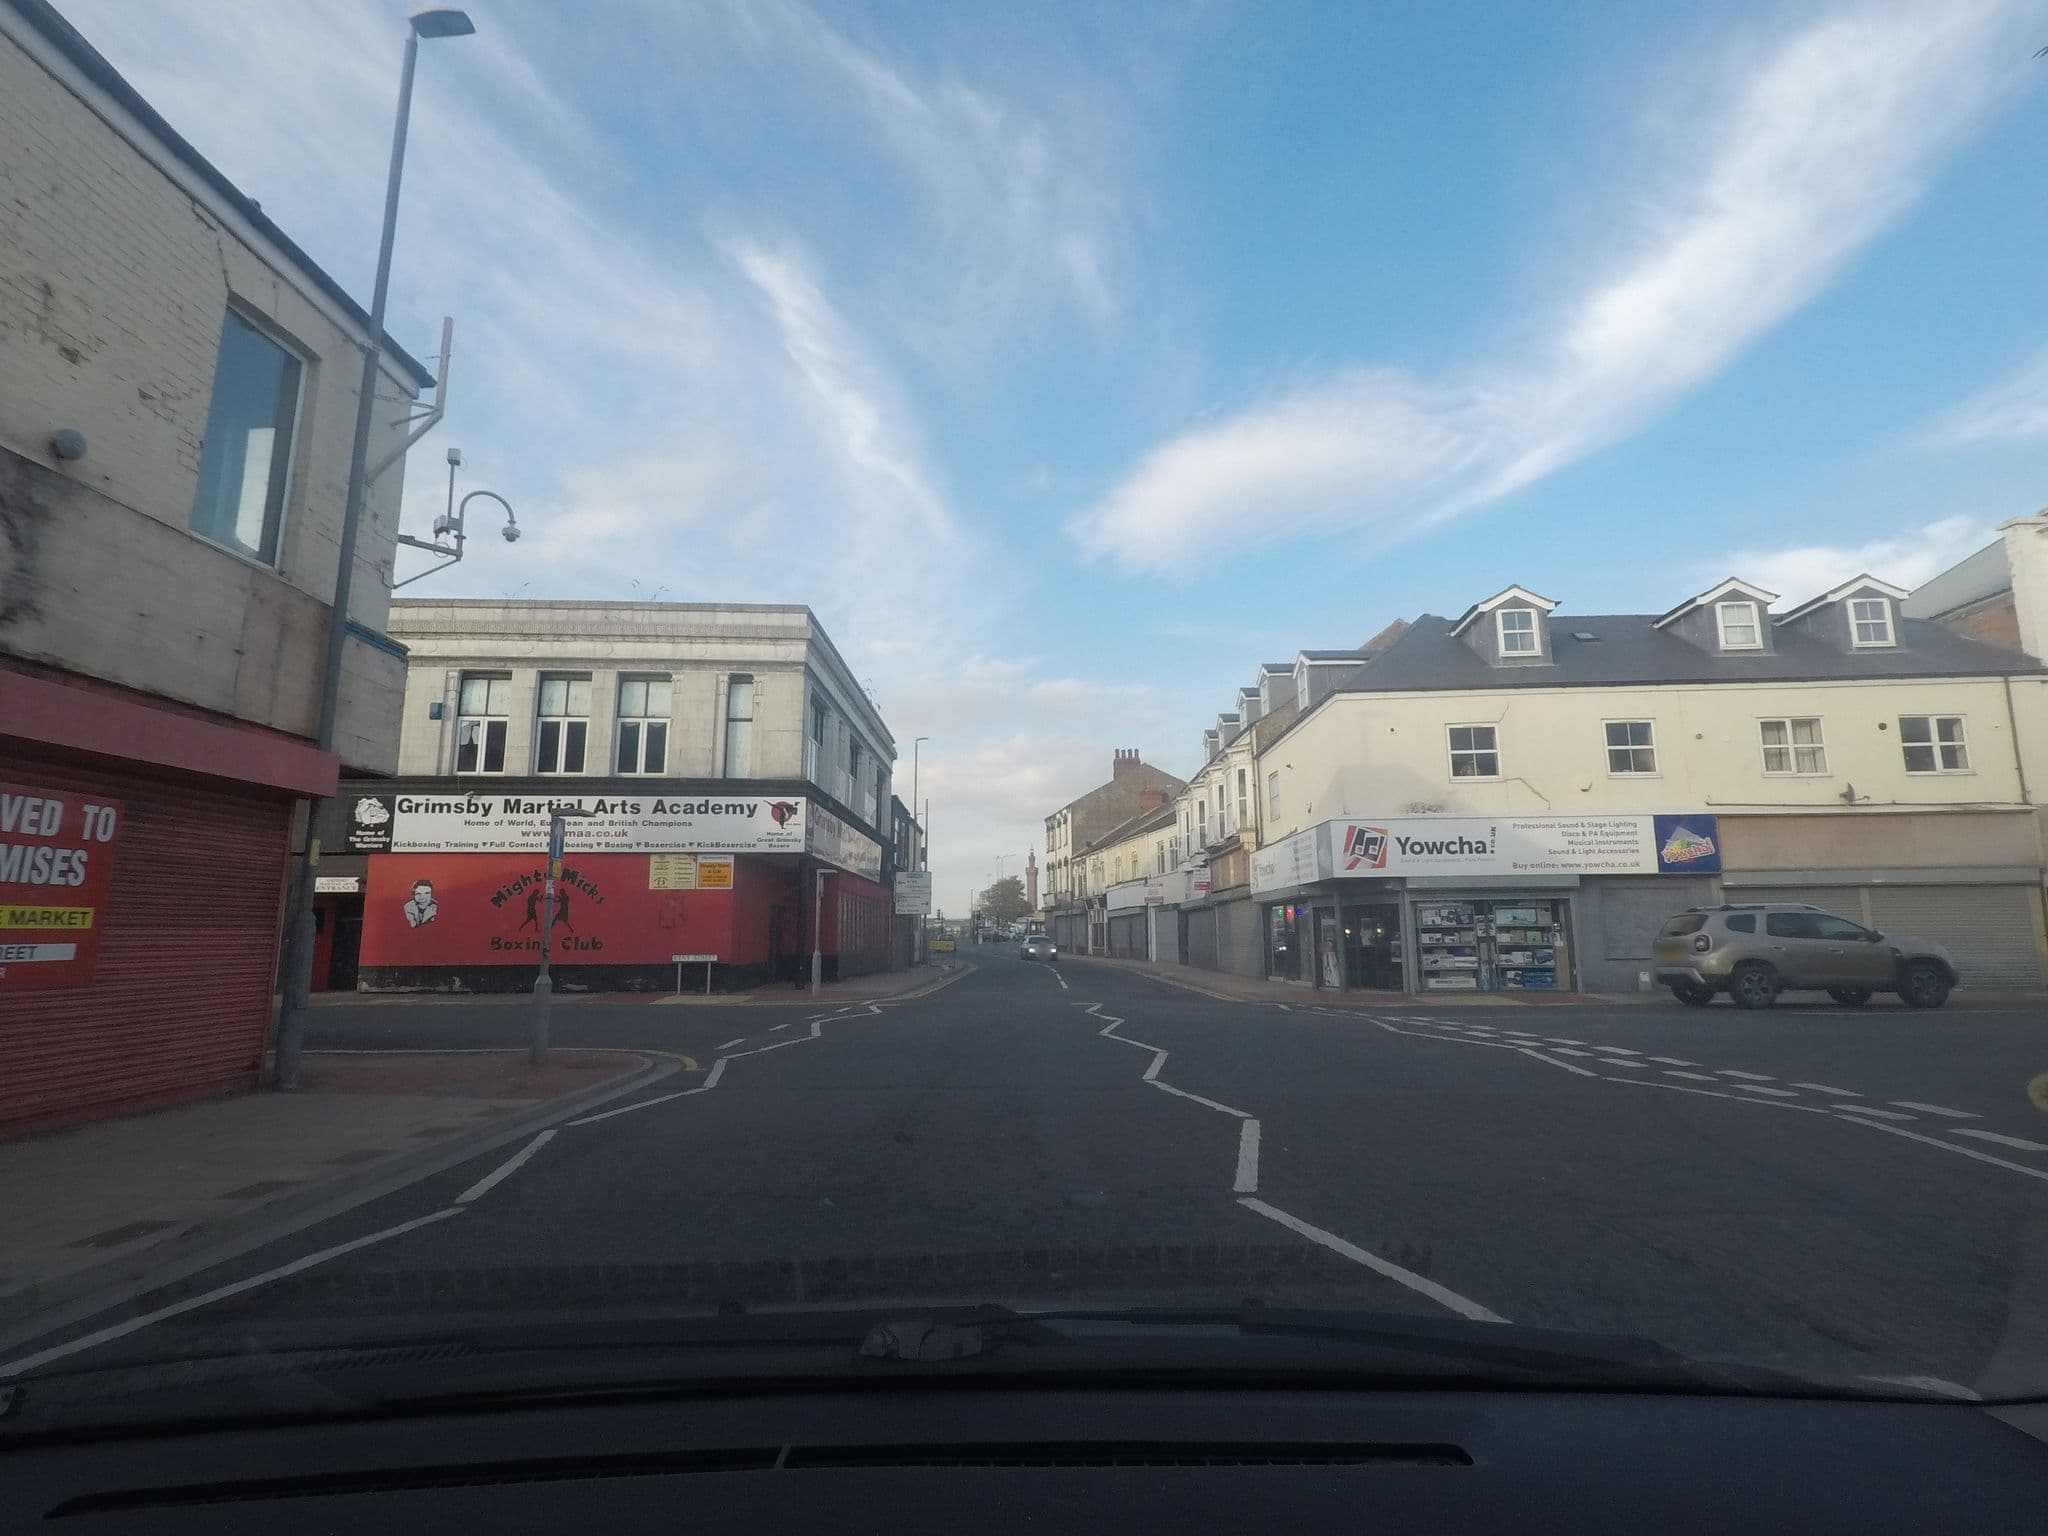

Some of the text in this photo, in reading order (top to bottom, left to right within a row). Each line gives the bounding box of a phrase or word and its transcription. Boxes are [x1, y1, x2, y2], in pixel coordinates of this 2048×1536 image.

[397, 798, 757, 817] Grimsby Martial Arts Academy
[82, 804, 117, 842] TO
[507, 819, 536, 828] World,
[540, 819, 583, 827] Euean
[587, 819, 605, 827] and
[608, 819, 638, 827] British
[641, 819, 693, 829] Champions
[1512, 822, 1556, 830] Professional
[1608, 821, 1638, 829] Lighting
[1600, 830, 1638, 838] Equipment
[393, 841, 441, 850] Kickboxing
[445, 841, 479, 850] Training
[489, 841, 505, 849] Full
[509, 841, 543, 849] Contact
[604, 841, 633, 850] Boxing
[644, 841, 686, 849] Boxercise
[696, 841, 757, 849] KickBoxercise
[1512, 861, 1640, 870] Buy online: www.yowcha.co.uk
[491, 869, 547, 908] Might
[8, 910, 91, 927] MARKET
[490, 936, 603, 951] Boxin Club
